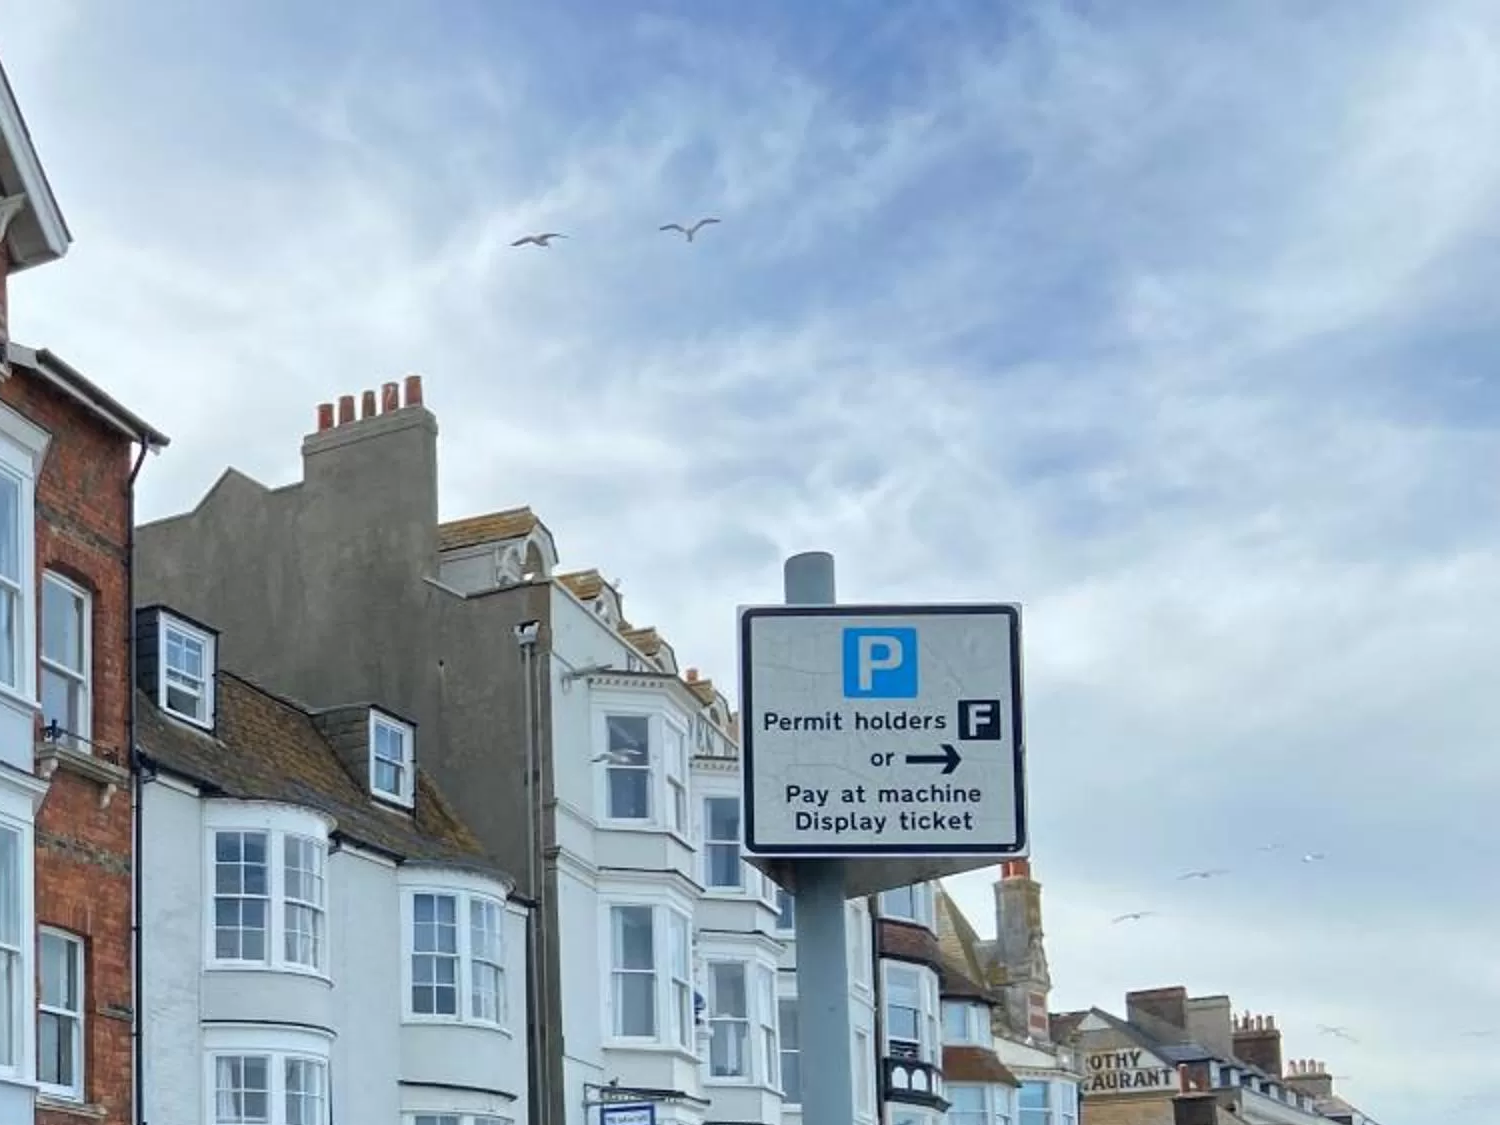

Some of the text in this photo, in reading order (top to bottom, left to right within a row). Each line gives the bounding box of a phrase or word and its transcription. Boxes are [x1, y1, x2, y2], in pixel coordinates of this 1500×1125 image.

[857, 635, 903, 691] P
[763, 703, 993, 737] Permit holders F
[870, 752, 895, 767] or
[785, 784, 982, 807] Pay at machine
[795, 811, 974, 834] Display ticket
